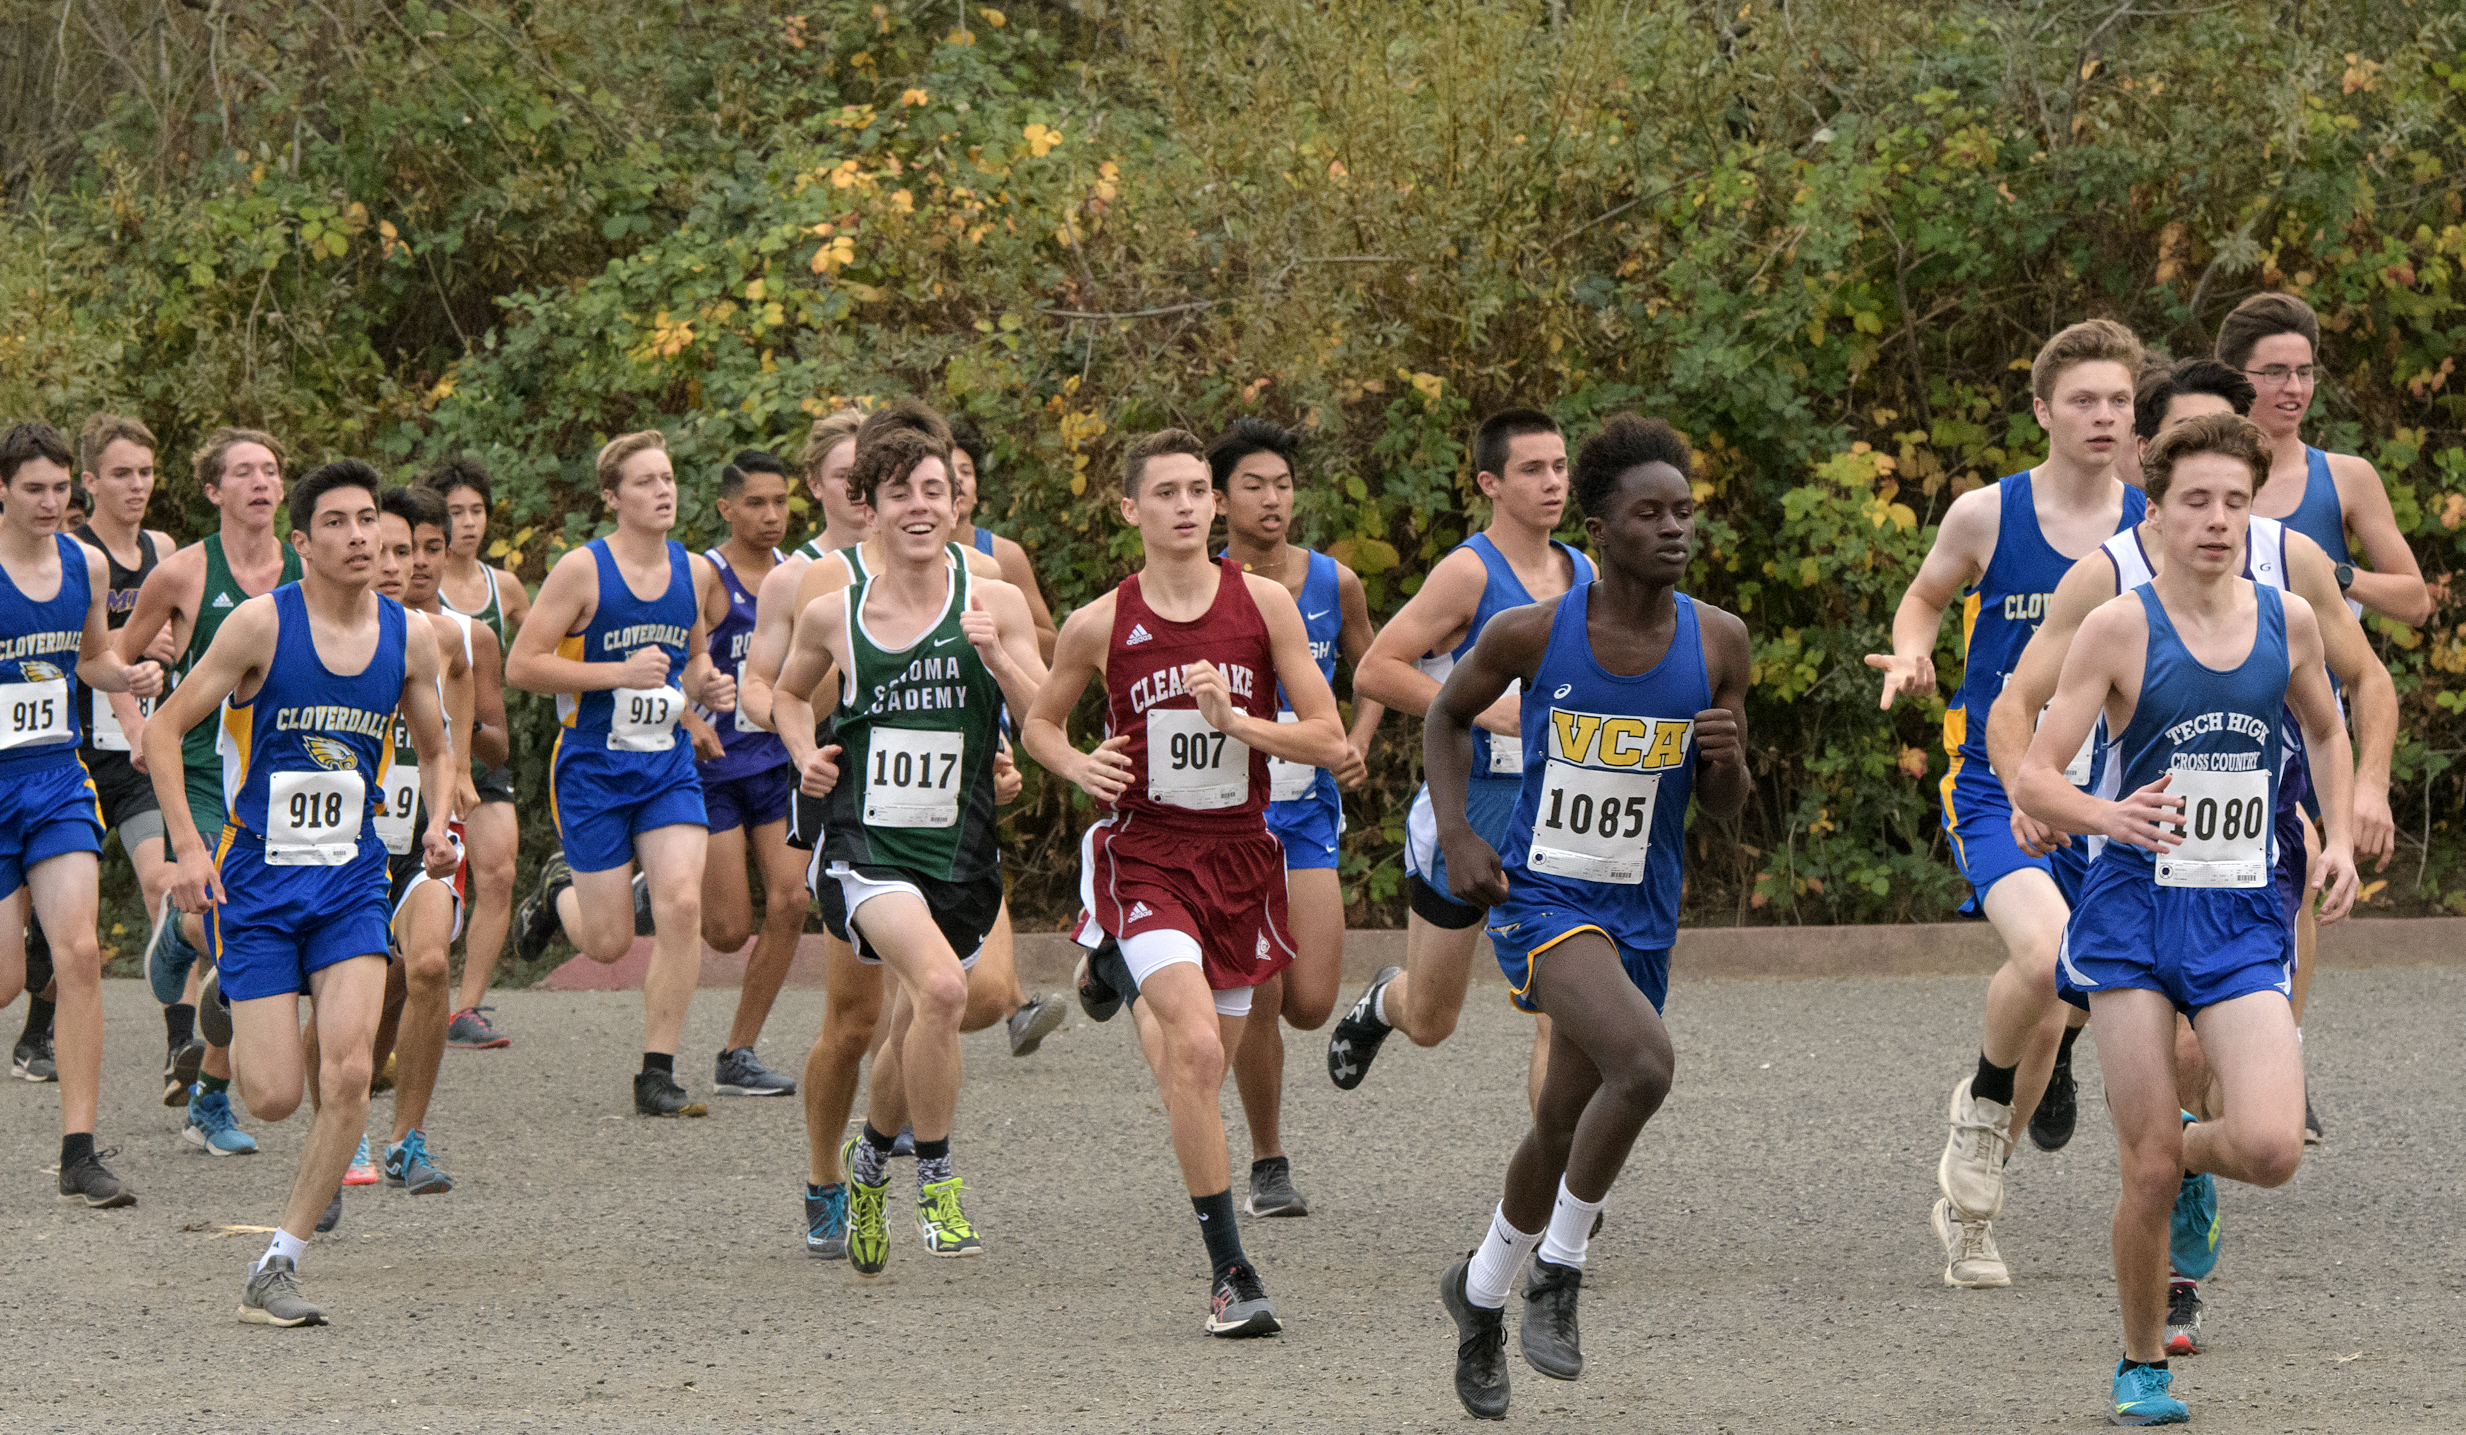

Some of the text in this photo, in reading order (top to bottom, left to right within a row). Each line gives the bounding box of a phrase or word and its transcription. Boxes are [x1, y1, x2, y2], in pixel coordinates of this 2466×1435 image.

[603, 624, 690, 651] CLOVERDALE
[1219, 662, 1254, 699] AKE
[13, 699, 54, 732] 915
[276, 705, 389, 740] CLOVERDALE
[629, 696, 669, 735] 913
[2165, 712, 2224, 746] TECH
[1170, 731, 1228, 770] 907
[1552, 710, 1691, 769] VCA
[873, 749, 958, 789] 1017
[2170, 751, 2262, 772] CROSS COUNTRY
[289, 792, 343, 828] 918
[1545, 788, 1647, 838] 1085
